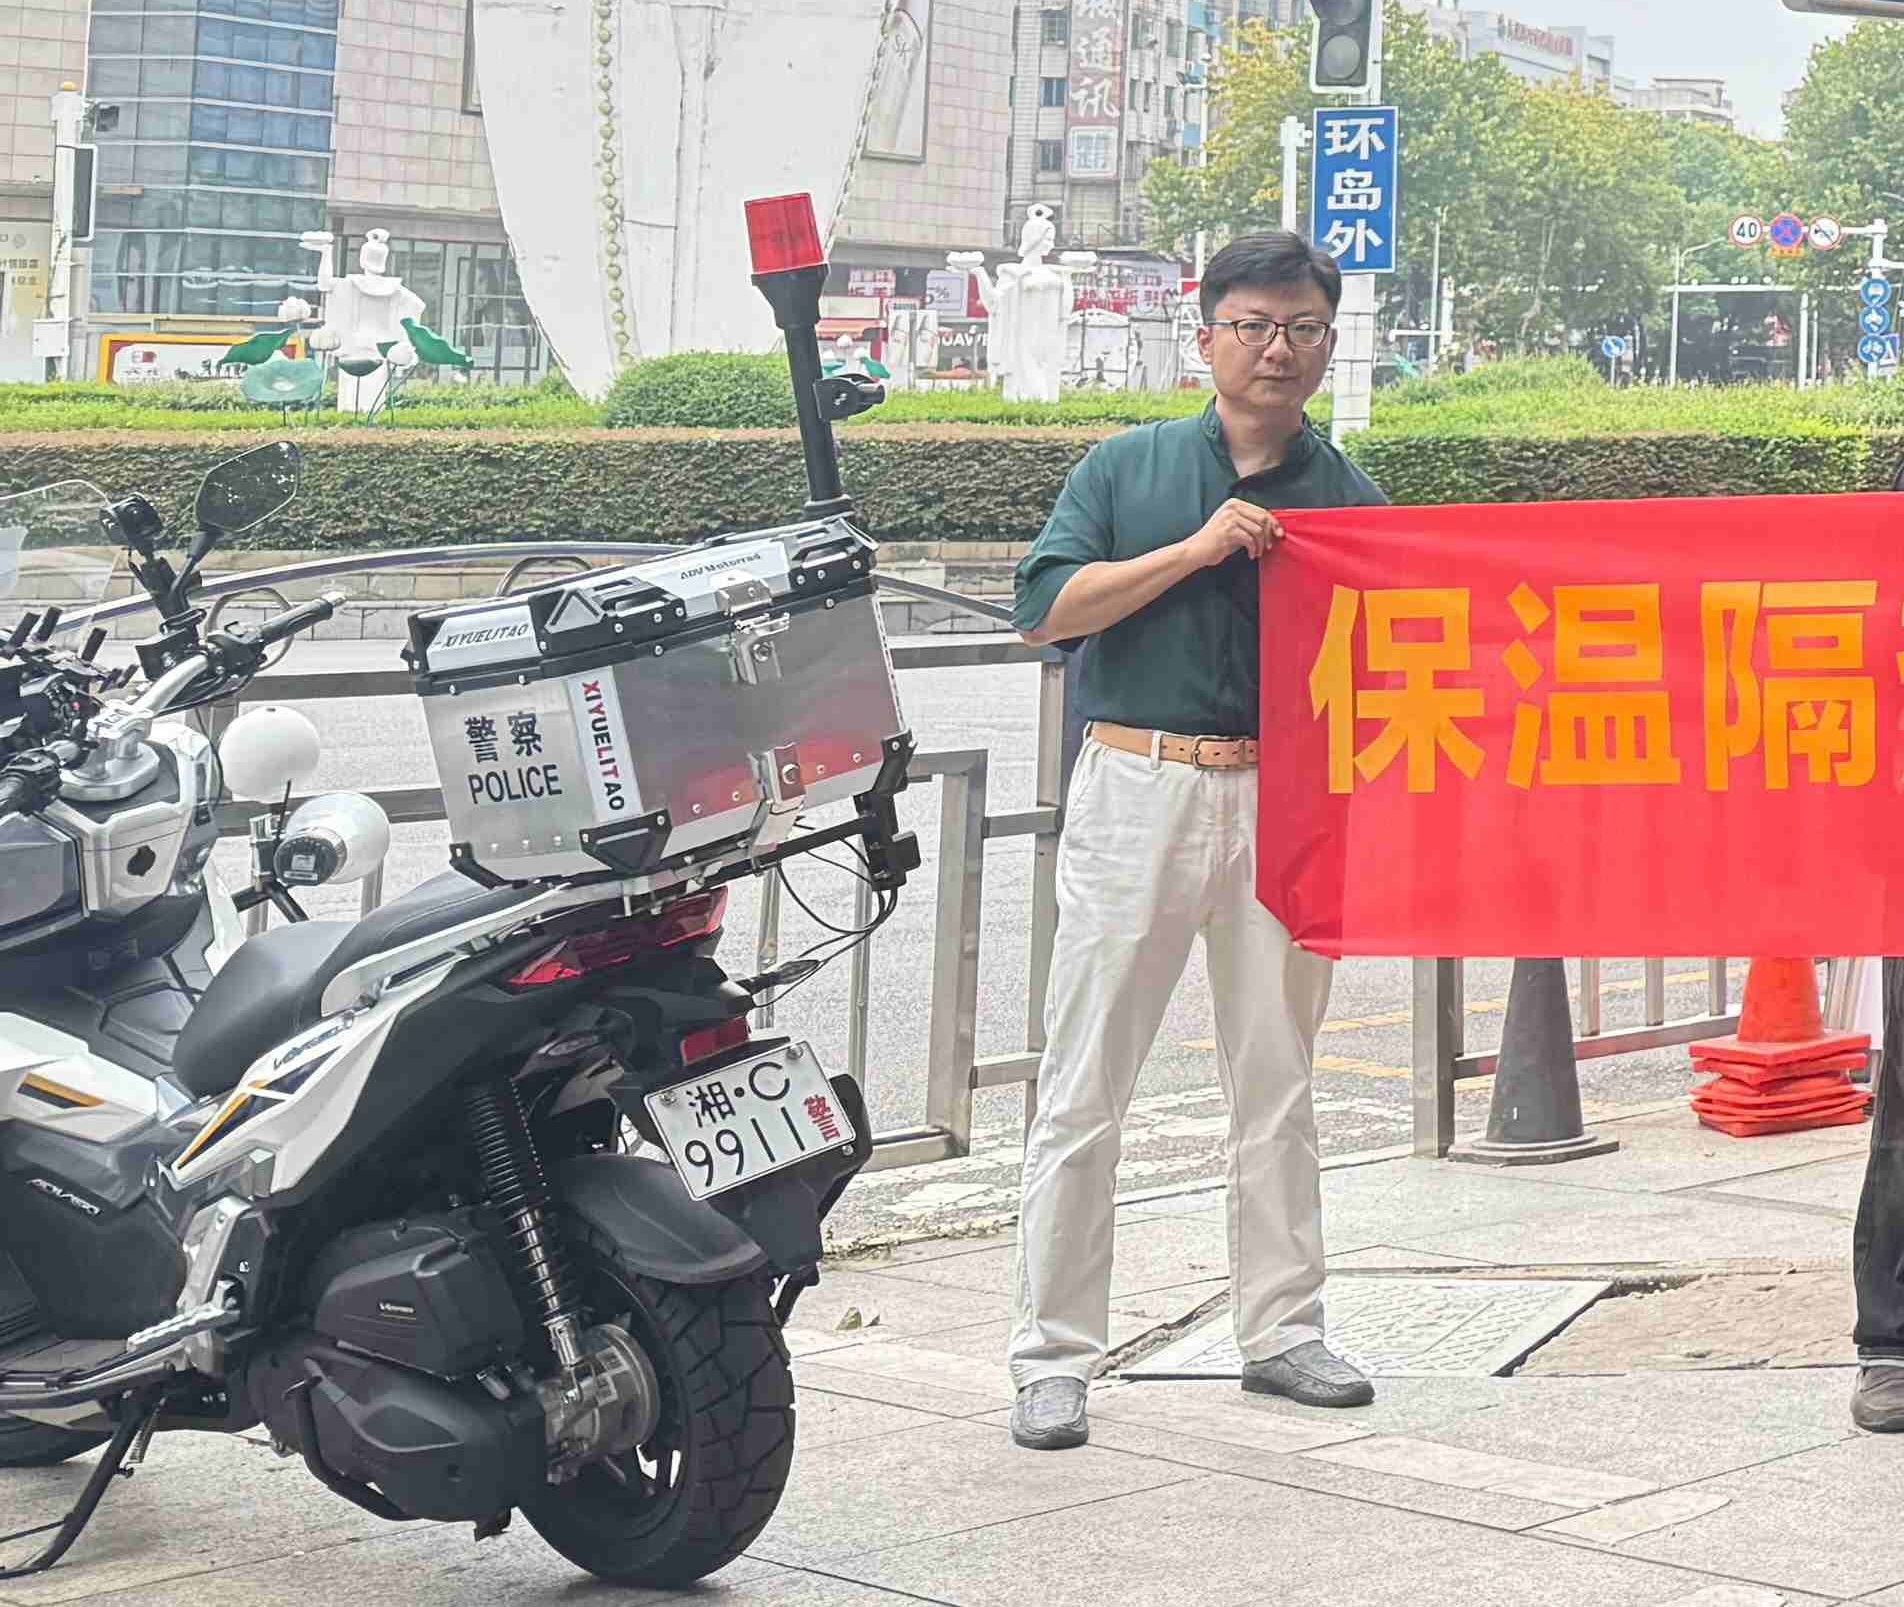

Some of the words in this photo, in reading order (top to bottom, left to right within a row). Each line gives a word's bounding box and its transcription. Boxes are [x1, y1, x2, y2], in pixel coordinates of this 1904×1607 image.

[1323, 117, 1385, 263] 环岛外
[1736, 221, 1758, 238] 40
[464, 710, 543, 765] 警察
[582, 680, 625, 811] XIYUELITAO
[467, 764, 563, 805] POLICE
[685, 1106, 806, 1188] 9911
